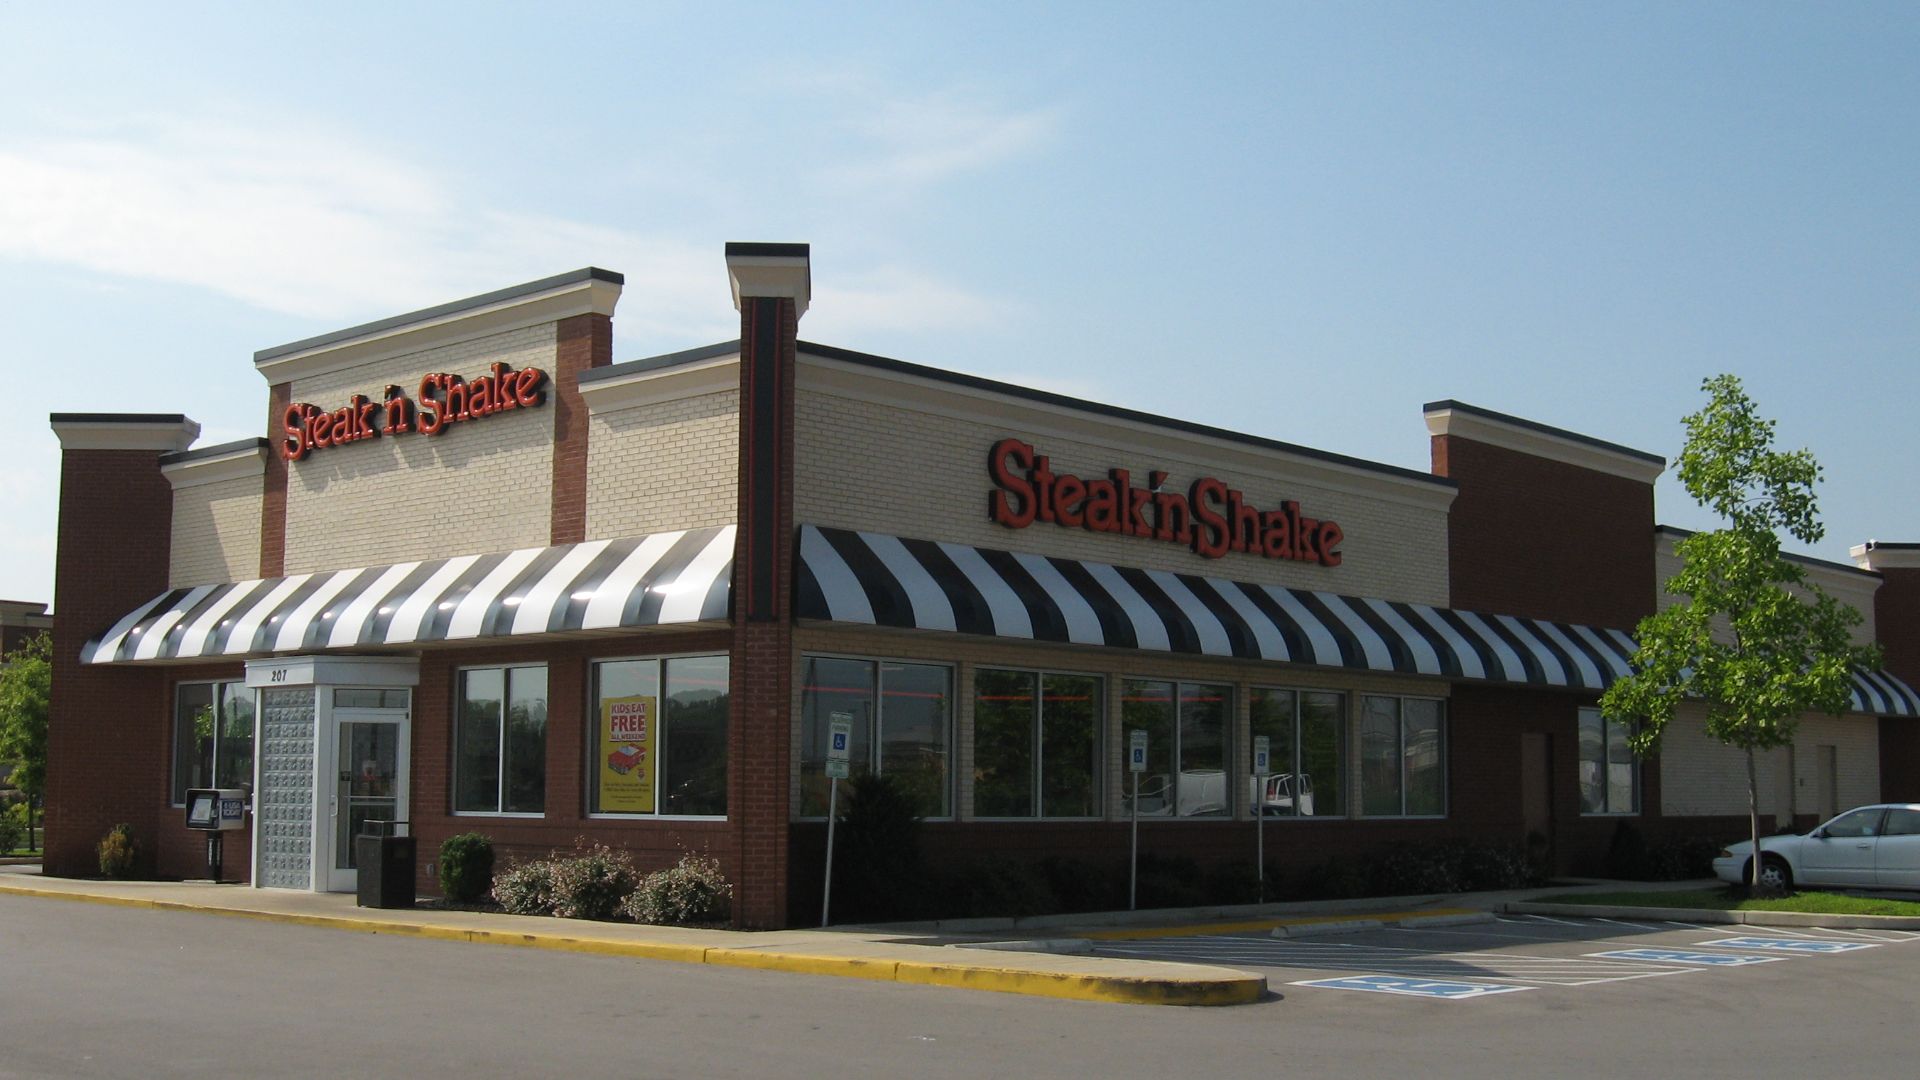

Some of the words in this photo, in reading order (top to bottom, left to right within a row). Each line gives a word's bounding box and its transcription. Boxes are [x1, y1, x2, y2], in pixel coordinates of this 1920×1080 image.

[284, 394, 380, 461] Steak
[417, 362, 549, 436] Shake
[988, 438, 1154, 539] Steak
[1190, 477, 1344, 567] Shake
[271, 669, 287, 682] 207
[611, 703, 630, 714] KIDS
[631, 703, 646, 713] EAT
[611, 714, 646, 732] FREE
